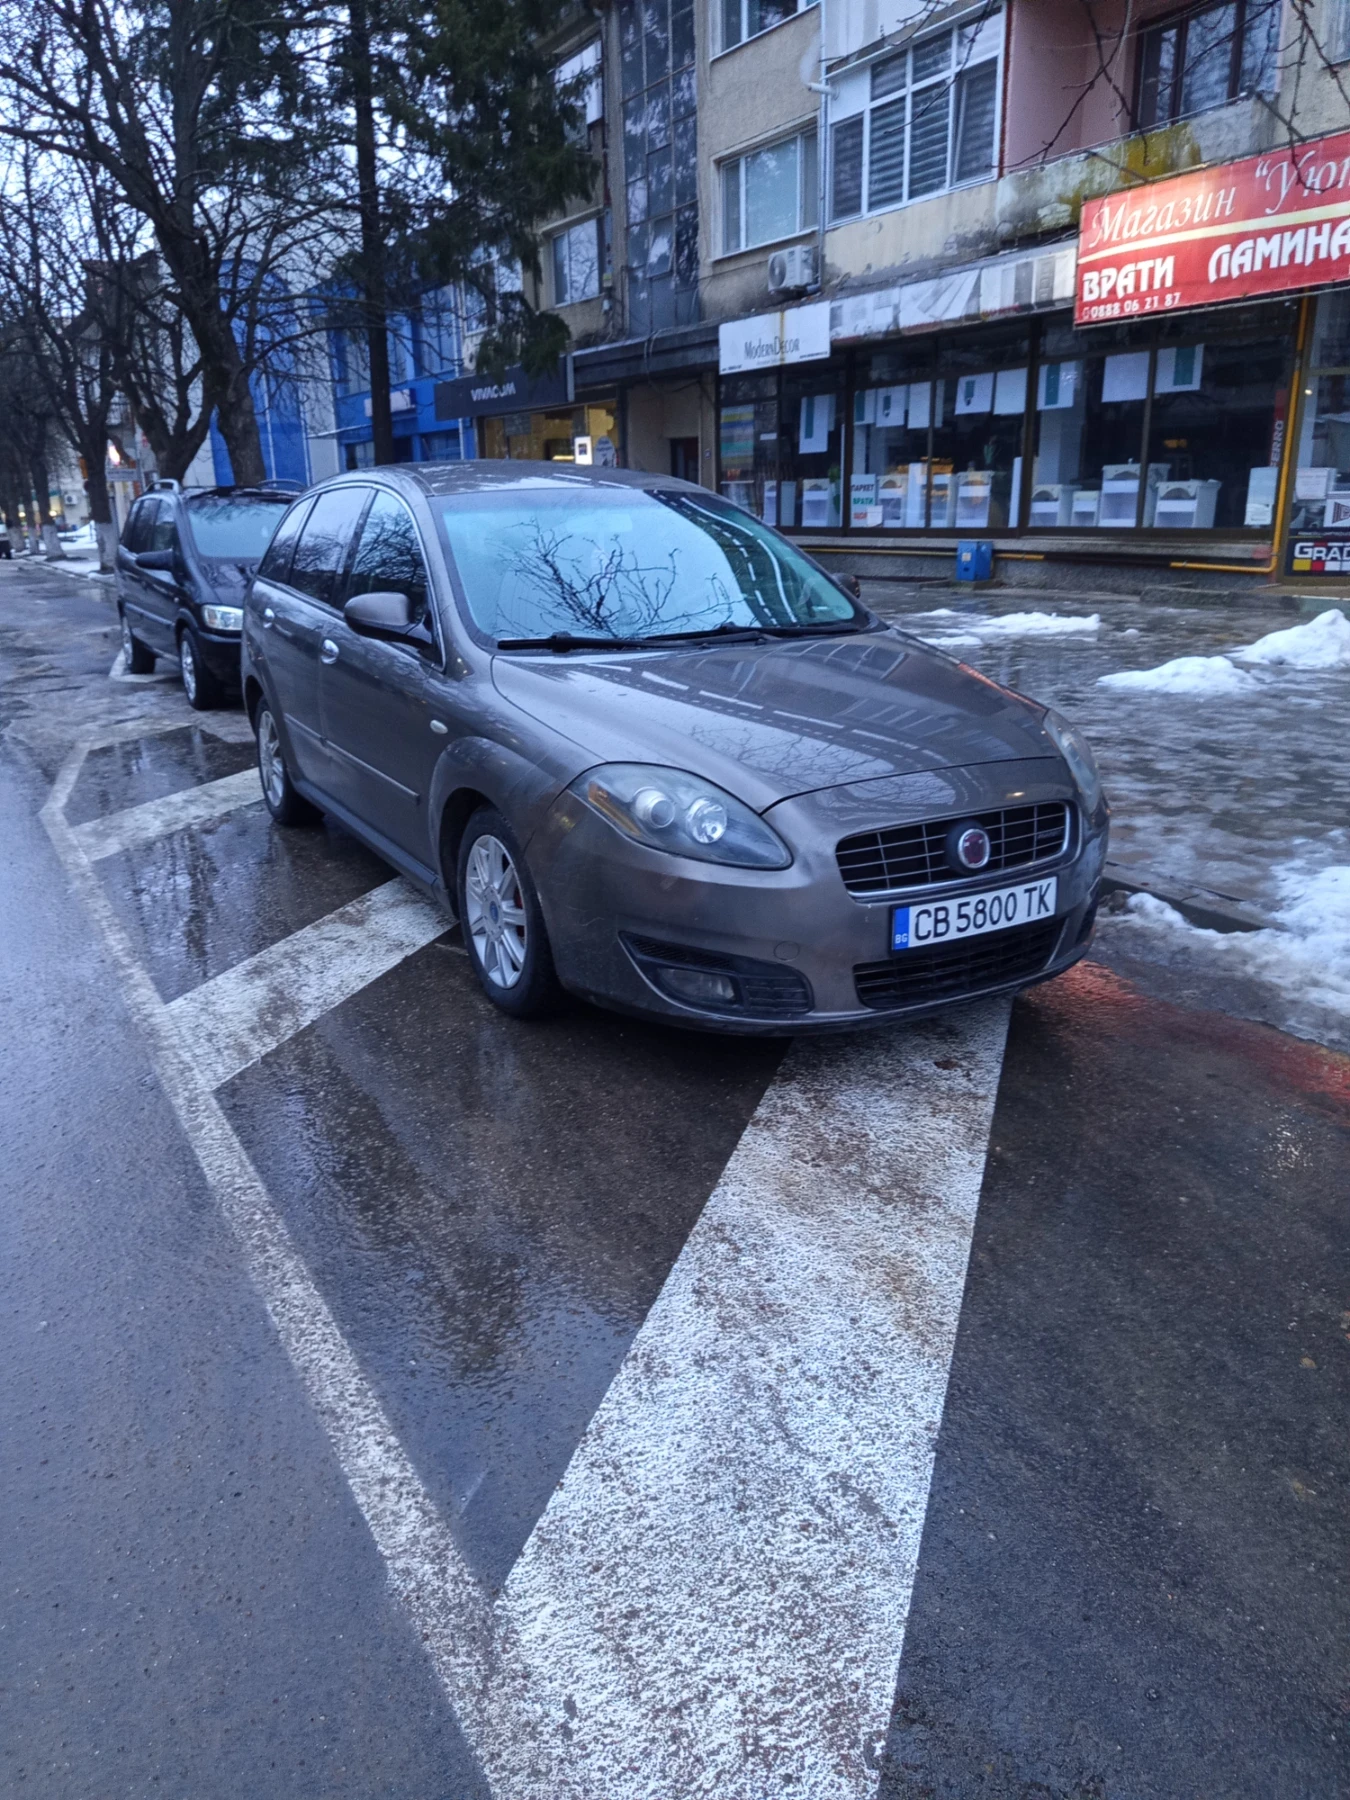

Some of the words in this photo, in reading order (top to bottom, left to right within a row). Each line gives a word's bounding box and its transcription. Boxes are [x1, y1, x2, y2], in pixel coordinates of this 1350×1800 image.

[1089, 187, 1236, 248] Магазин
[1082, 256, 1176, 302] ВРАТИ
[1090, 301, 1121, 319] 0888
[1124, 299, 1139, 312] 06
[1144, 295, 1159, 310] 21
[1164, 291, 1182, 307] 87
[895, 933, 908, 944] BG
[914, 906, 951, 941] CB
[956, 892, 1017, 933] 5800
[1024, 882, 1052, 918] TK
